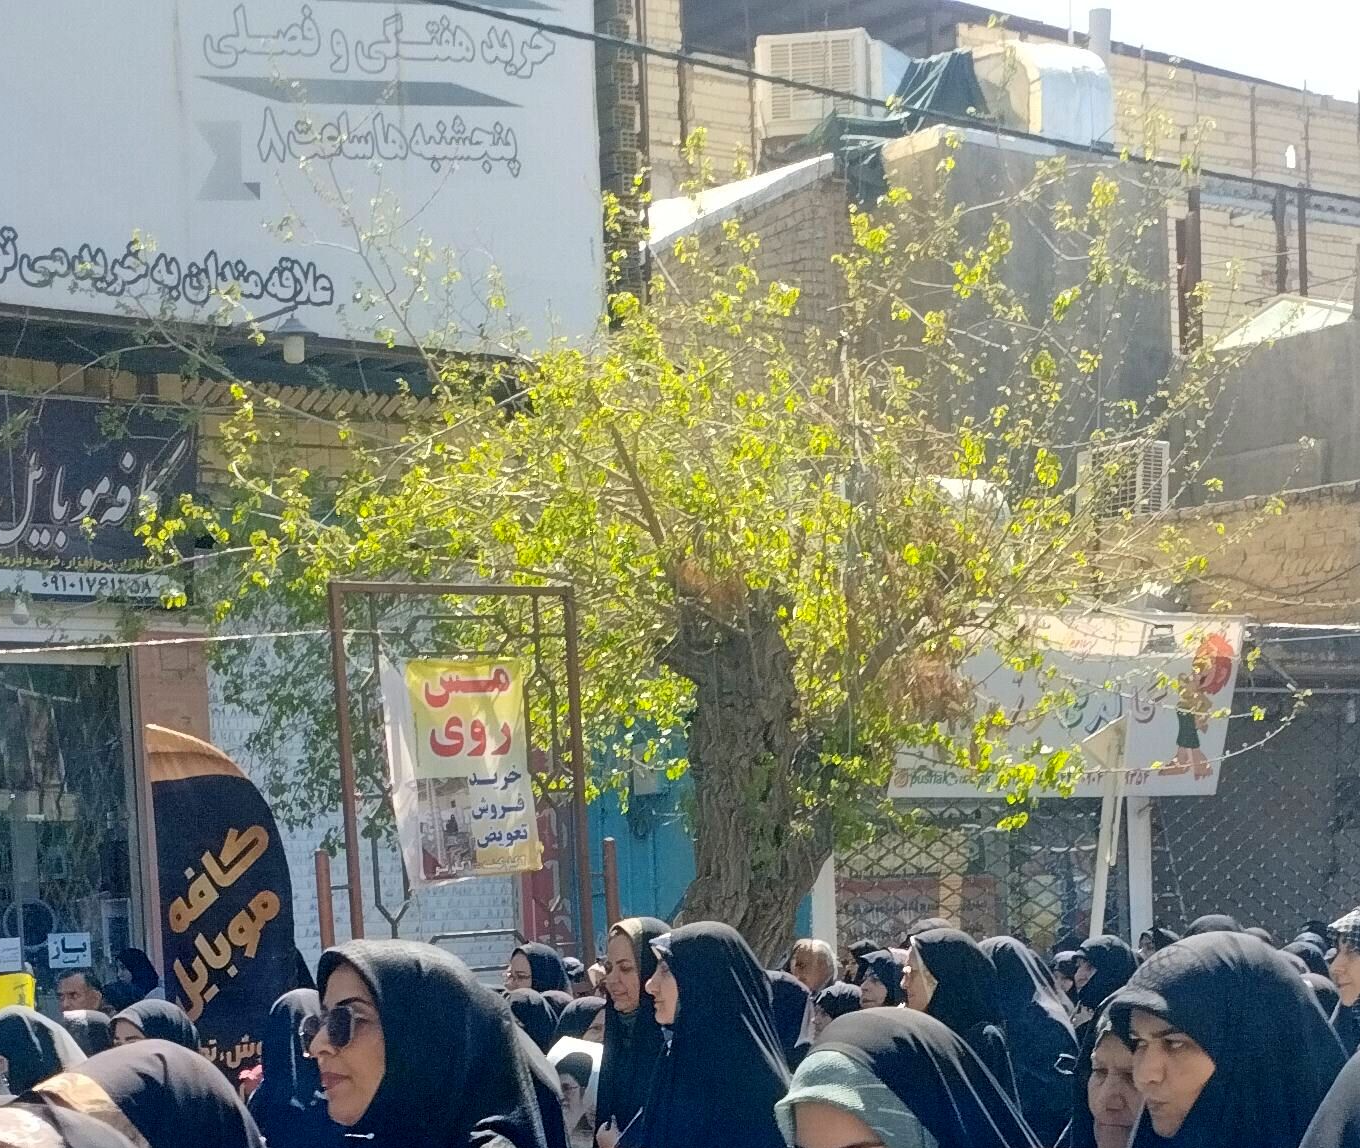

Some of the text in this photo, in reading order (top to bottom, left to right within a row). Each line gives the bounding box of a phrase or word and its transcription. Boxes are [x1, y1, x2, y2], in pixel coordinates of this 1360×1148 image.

[203, 3, 321, 70] فصلی
[329, 28, 350, 74] و
[424, 667, 511, 709] مس
[429, 715, 512, 758] روی
[468, 765, 522, 787] خرید
[471, 796, 526, 820] فروش
[477, 823, 528, 849] تعویض
[169, 825, 270, 934] کافه
[172, 889, 281, 1024] موبایل
